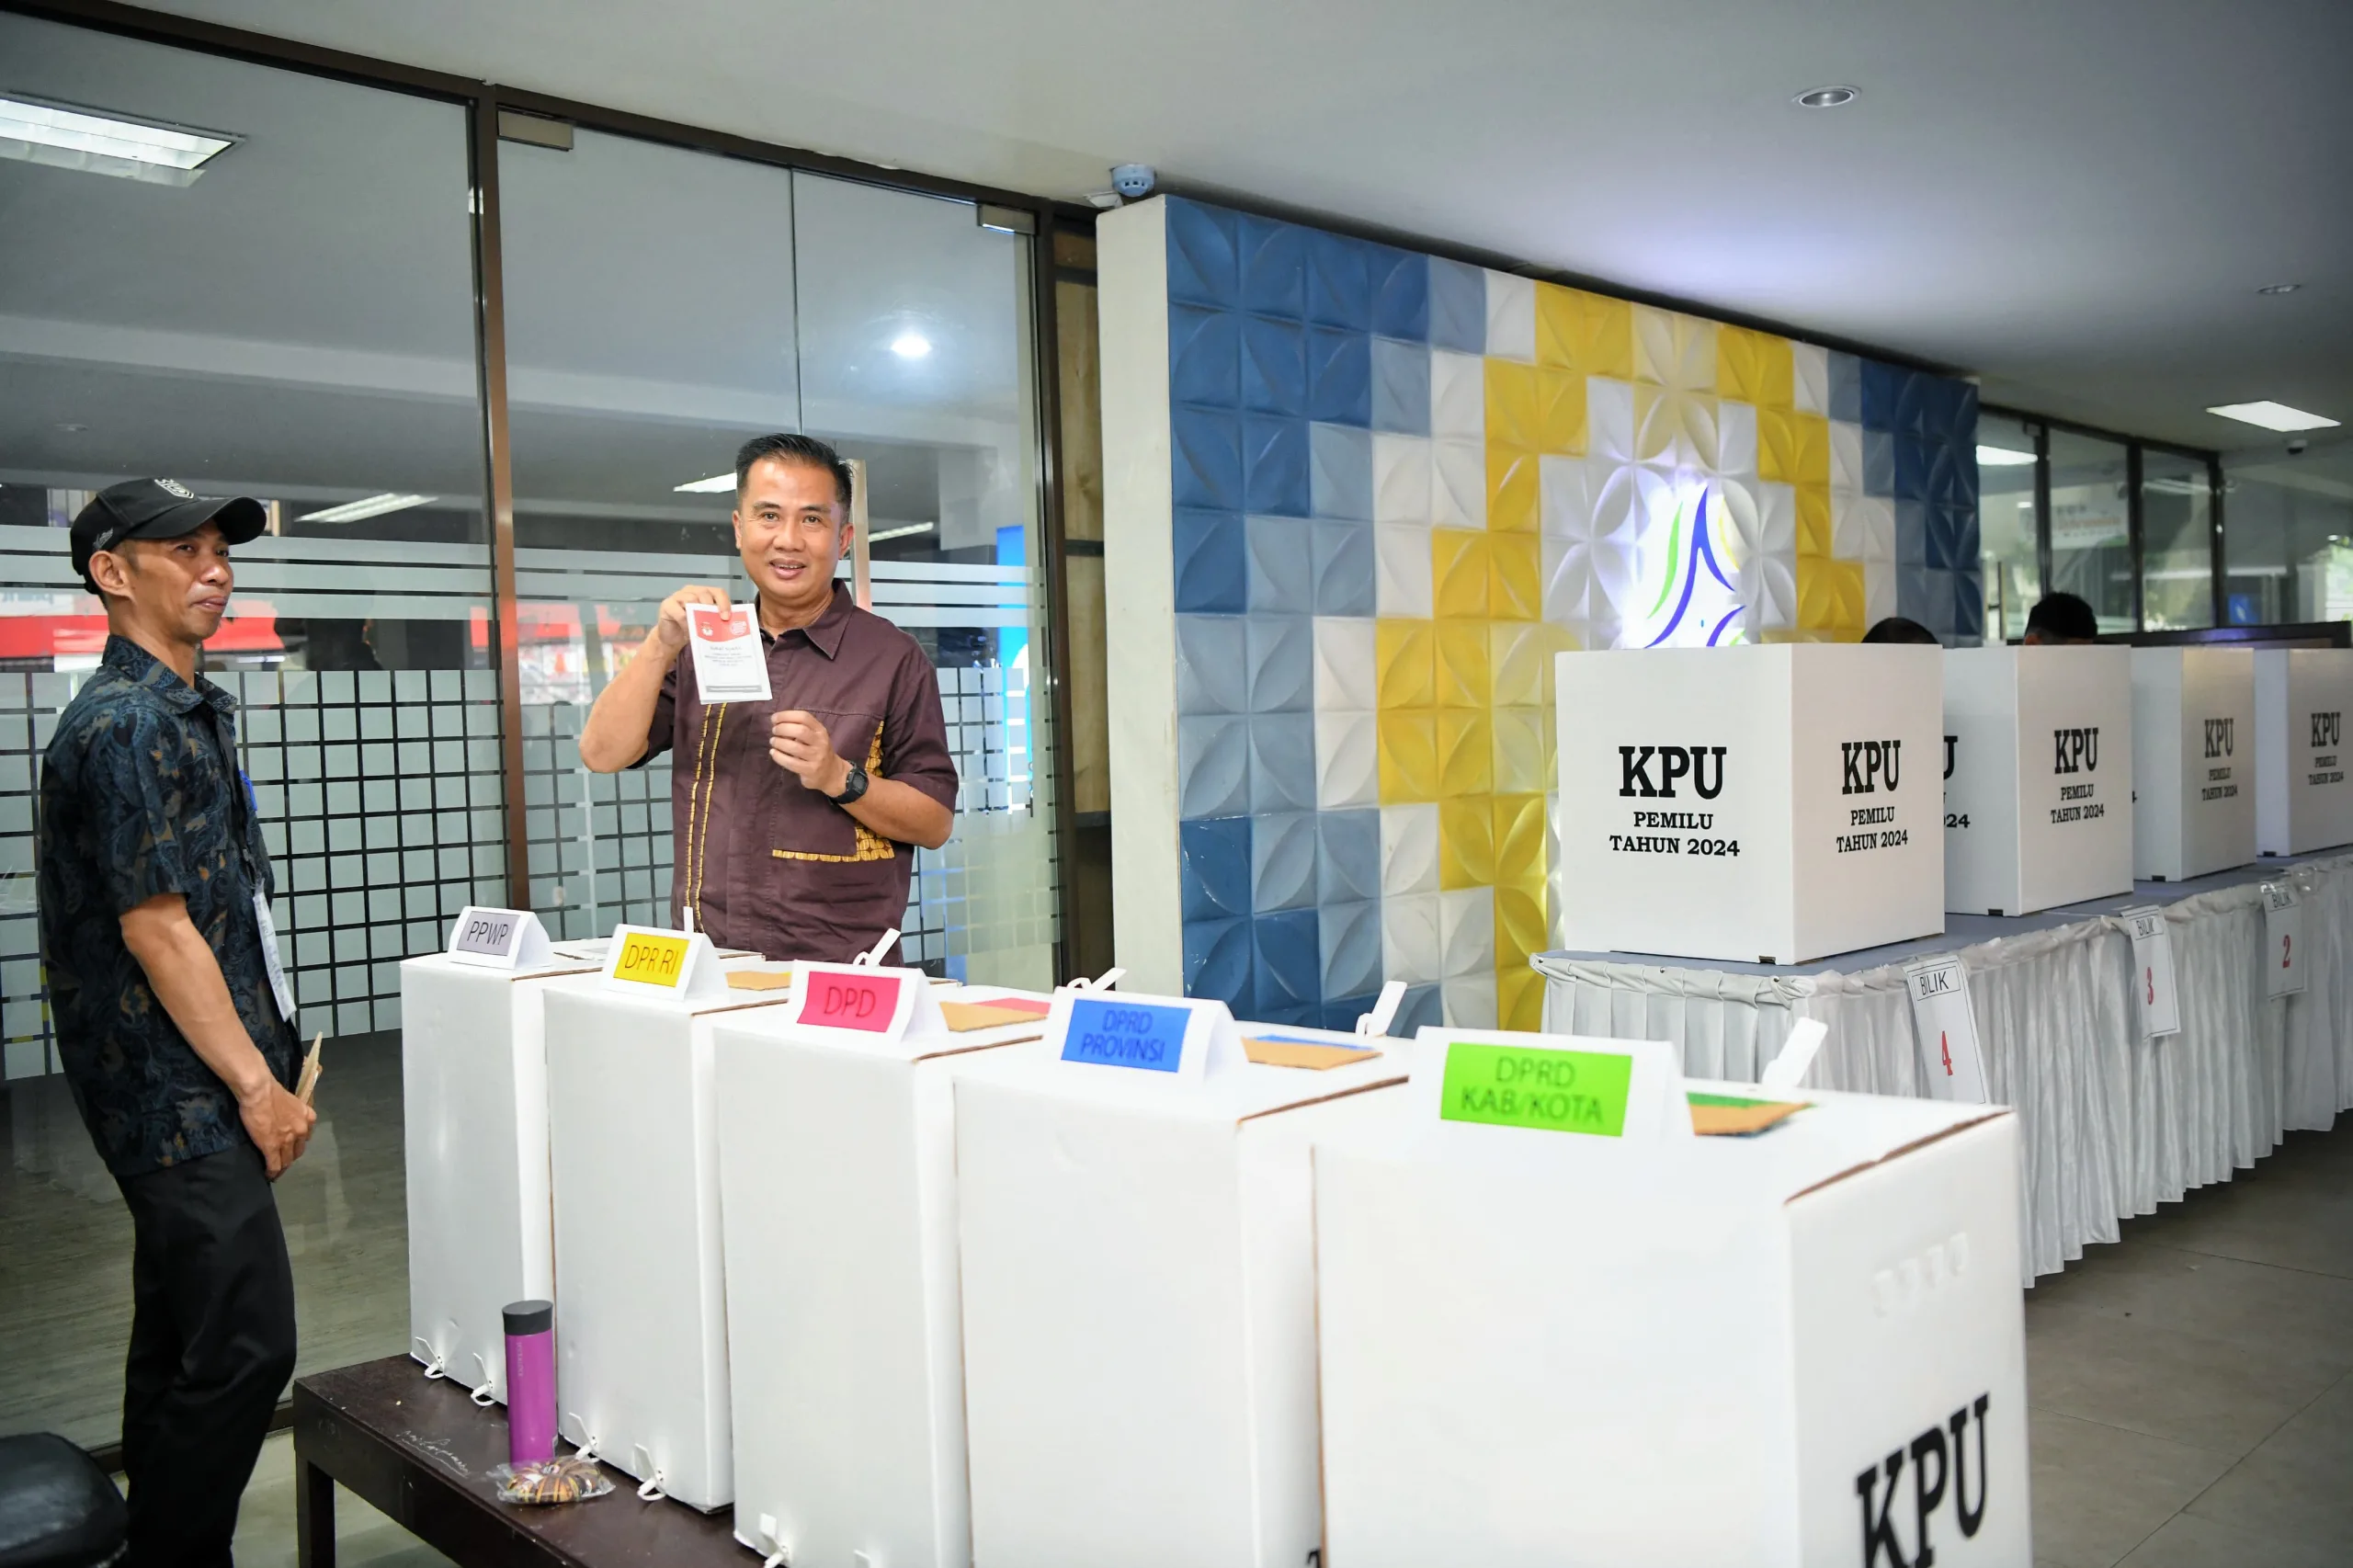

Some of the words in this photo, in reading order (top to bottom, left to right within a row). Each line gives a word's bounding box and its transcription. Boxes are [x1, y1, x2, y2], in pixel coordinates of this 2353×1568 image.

[2204, 718, 2234, 758] KPU
[2311, 711, 2341, 747] KPU
[2053, 727, 2099, 774] KPU
[1619, 745, 1727, 800] KPU
[1841, 740, 1902, 795] KPU
[2061, 784, 2094, 801] PEMILU
[1633, 812, 1713, 829] PEMILU
[1850, 806, 1895, 826] PEMILU
[1943, 813, 1971, 829] 24
[2051, 806, 2082, 824] TAHUN
[2083, 803, 2105, 821] 2024
[1609, 835, 1680, 854] TAHUN
[1688, 838, 1740, 857] 2024
[1836, 834, 1878, 853] TAHUN
[1881, 829, 1908, 848] 2024
[467, 921, 509, 946] PPWP
[624, 945, 659, 973] DPR
[659, 949, 678, 975] RI
[2282, 934, 2291, 969] 2
[1919, 971, 1949, 995] BILIK
[2146, 966, 2154, 1006] 3
[824, 986, 876, 1017] DPD
[1103, 1010, 1152, 1035] DPRD
[1081, 1035, 1165, 1062] PROVINSI
[1941, 1030, 1953, 1076] 4
[1495, 1056, 1576, 1088] DPRD
[1856, 1392, 1990, 1568] KPU
